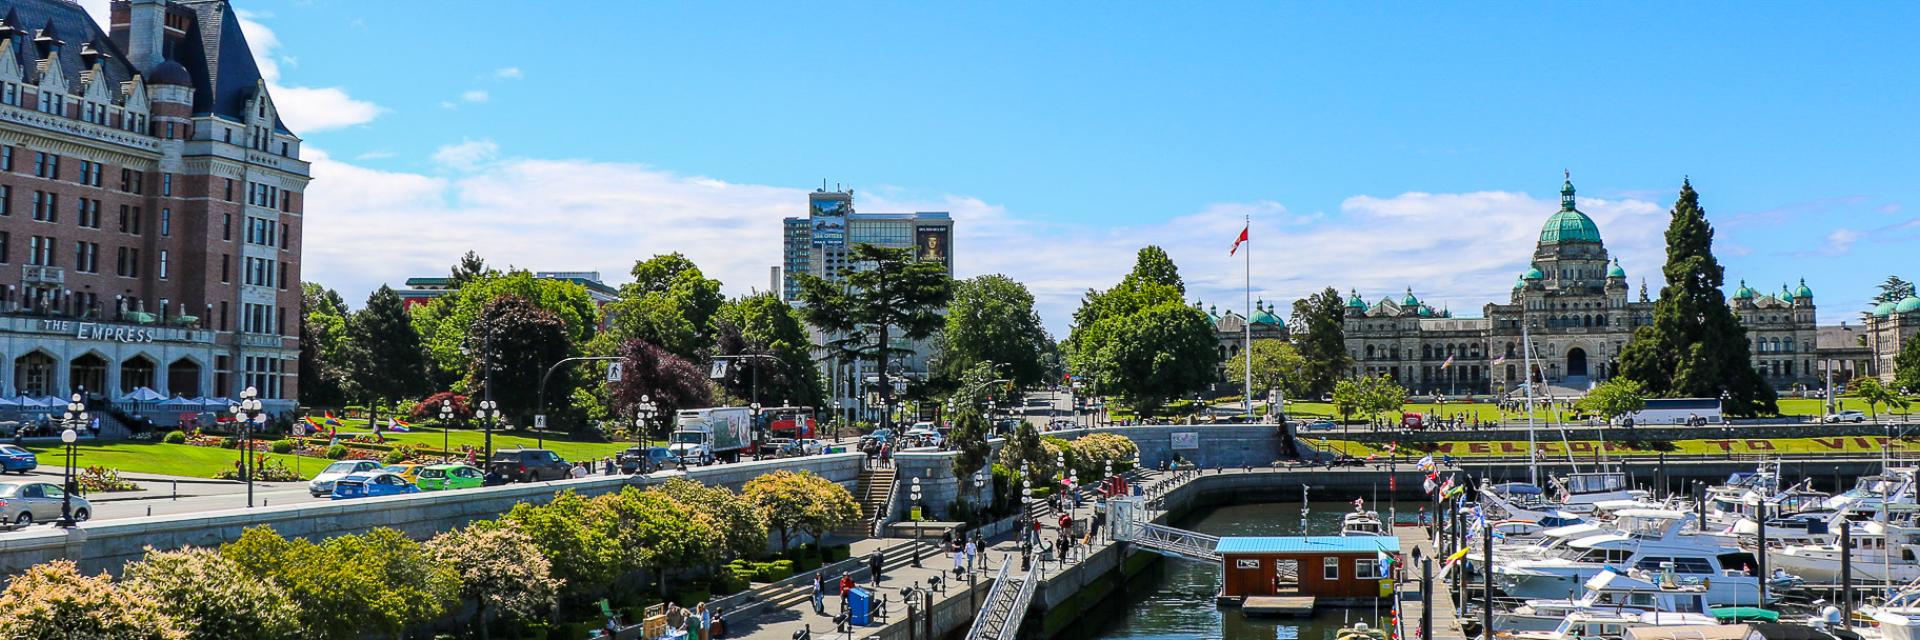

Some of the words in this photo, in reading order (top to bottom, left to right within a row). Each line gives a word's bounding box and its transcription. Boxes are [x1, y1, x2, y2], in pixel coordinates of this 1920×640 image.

[44, 319, 69, 331] THE
[77, 321, 153, 344] EMPRESS
[1703, 440, 1776, 450] TO
